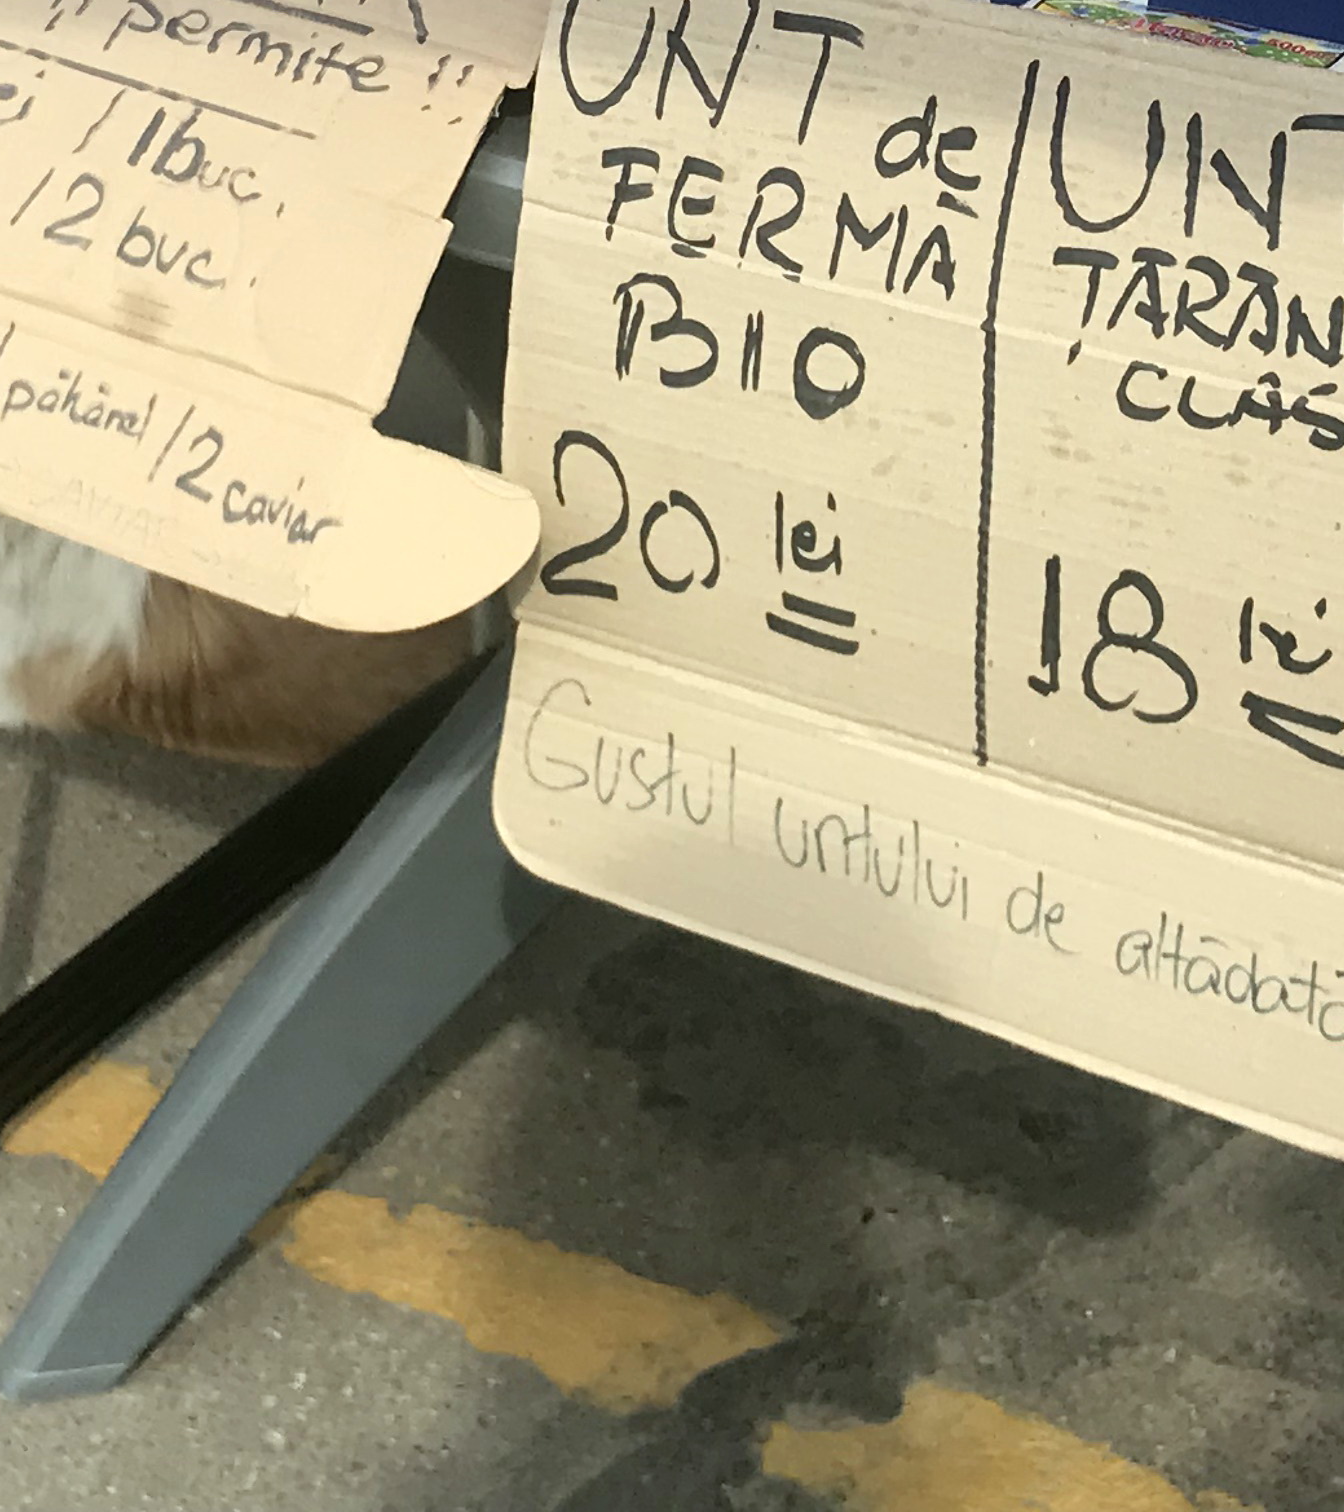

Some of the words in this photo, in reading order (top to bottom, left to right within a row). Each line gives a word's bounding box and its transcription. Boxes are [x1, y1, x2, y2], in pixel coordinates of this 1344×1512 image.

[875, 95, 983, 196] de
[613, 272, 867, 420] BIO
[222, 476, 345, 546] caviar
[539, 429, 723, 598] 20
[772, 491, 845, 577] lei
[1028, 553, 1202, 724] 18
[522, 678, 739, 845] Gustul
[1003, 871, 1074, 956] de
